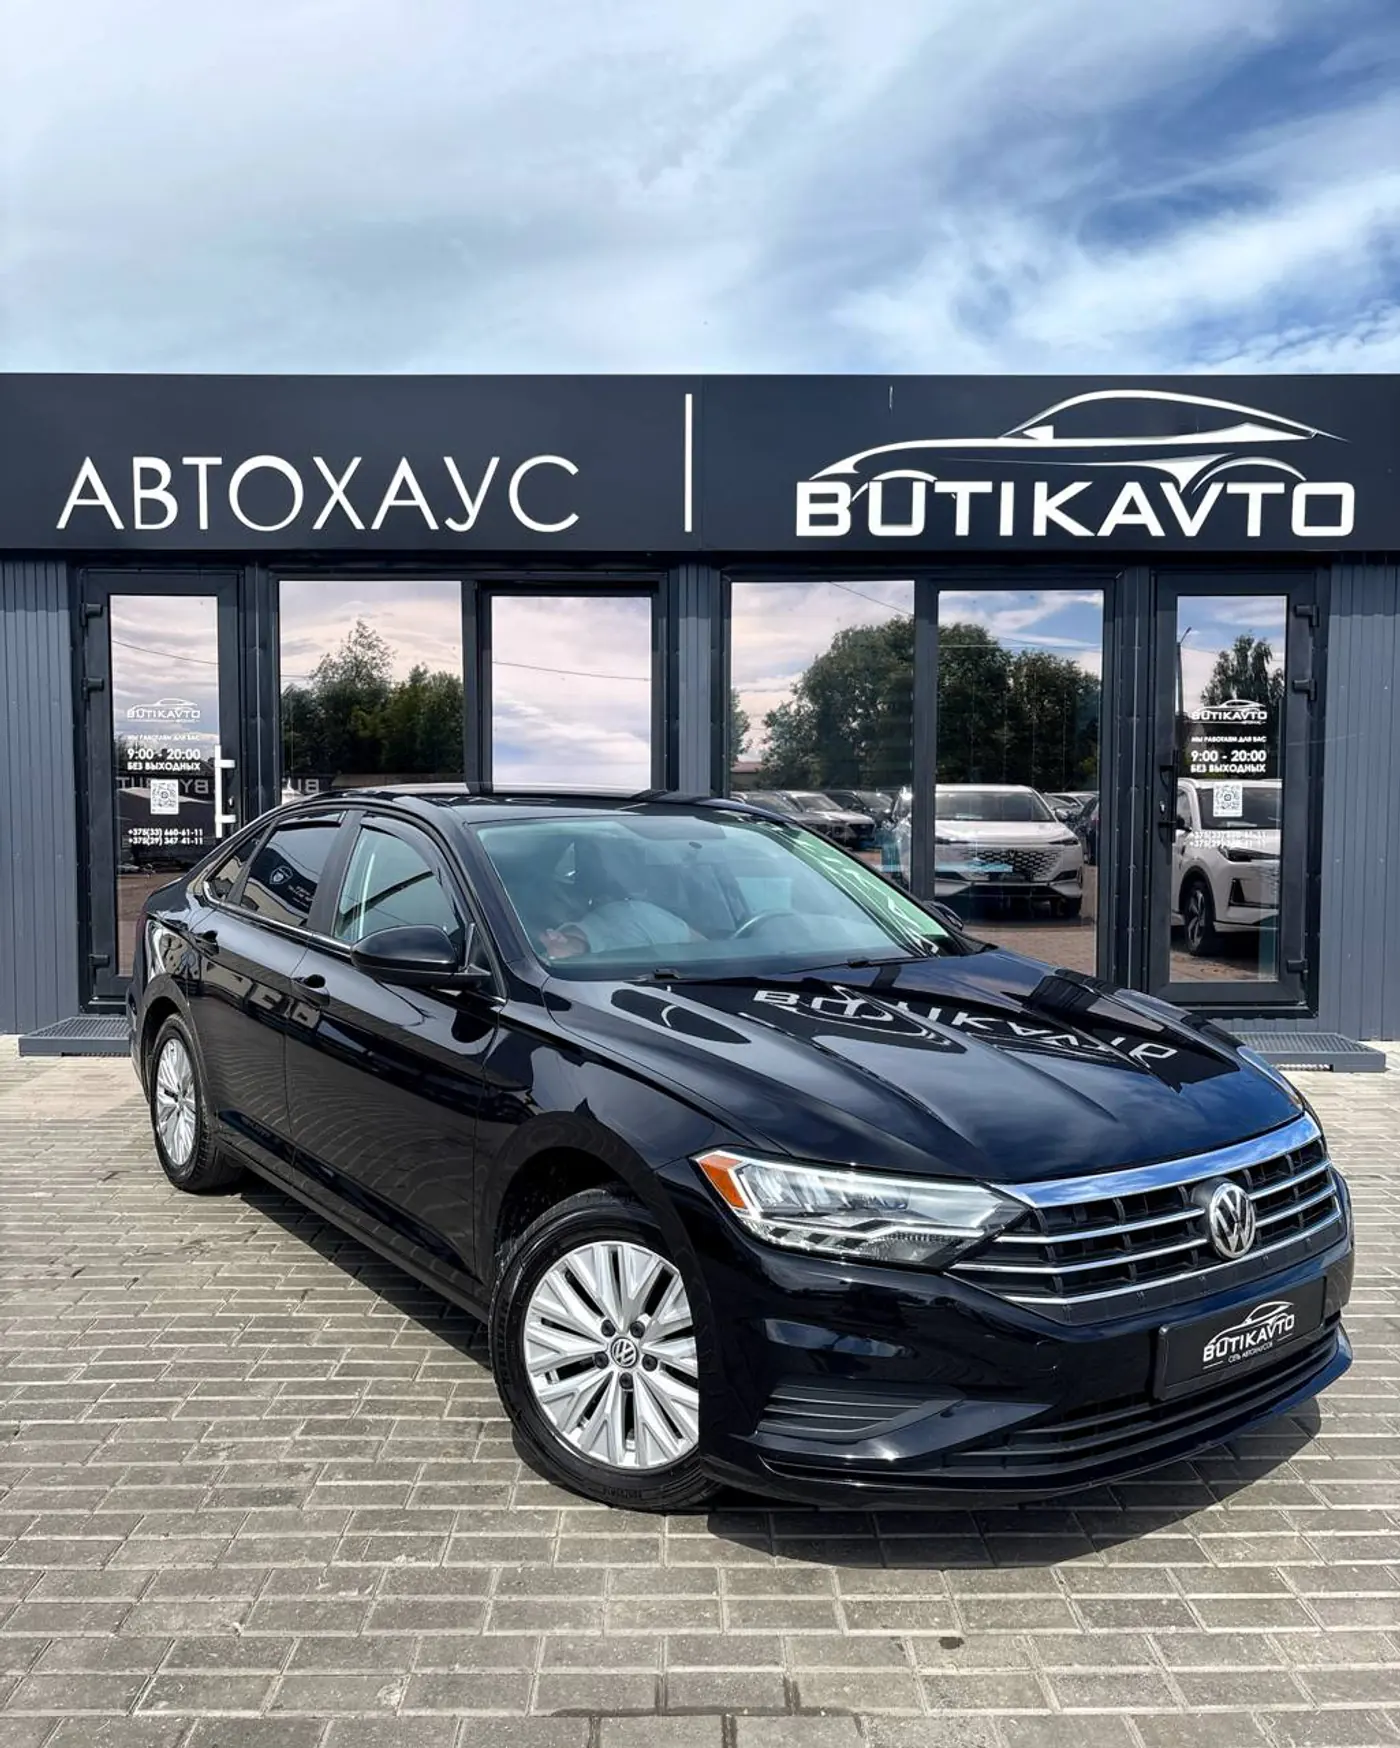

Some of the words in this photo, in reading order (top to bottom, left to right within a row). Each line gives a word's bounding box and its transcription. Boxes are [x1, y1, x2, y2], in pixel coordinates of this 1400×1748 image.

[57, 455, 580, 533] АВТОХАУС
[796, 481, 1355, 537] BUTIKAVTO
[127, 710, 201, 719] BUTIKAVTO
[1191, 711, 1268, 720] BUTIKAVTO
[127, 749, 154, 760] 9:00
[166, 749, 201, 760] 20:00
[1191, 750, 1219, 762] 9:00
[1230, 750, 1267, 762] 20:00
[127, 762, 143, 771] БЕЗ
[145, 762, 201, 771] ВЫХОДНЫХ
[1190, 764, 1207, 773] БЕЗ
[1208, 764, 1266, 773] ВЫХОДНЫХ
[1202, 1314, 1295, 1362] BUTIKAVTO
